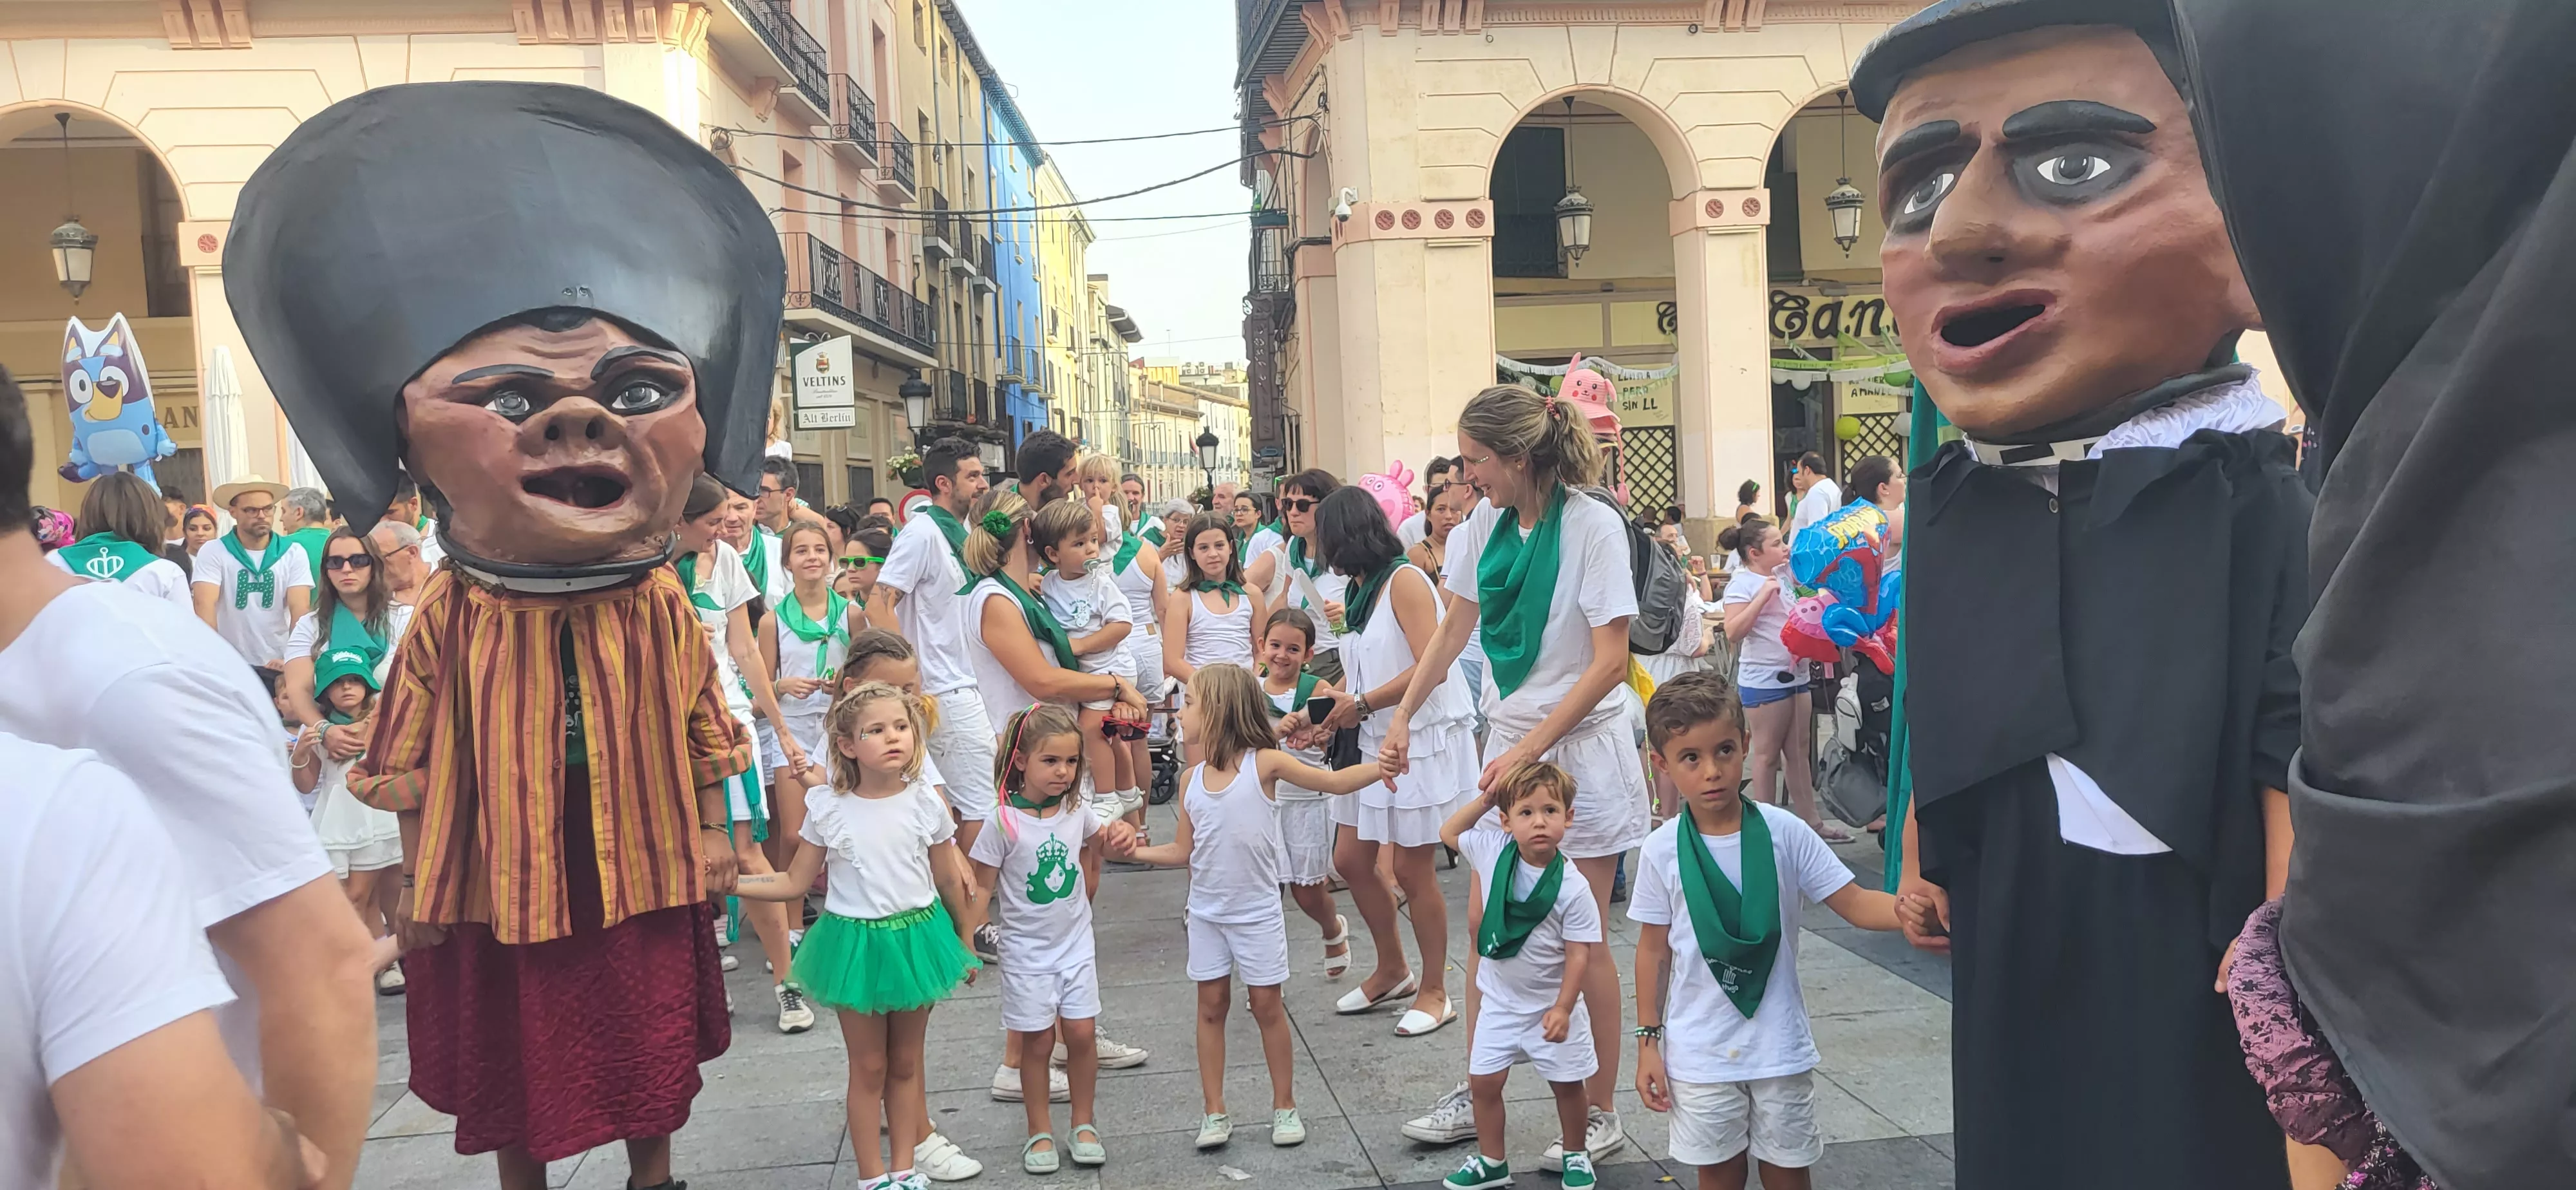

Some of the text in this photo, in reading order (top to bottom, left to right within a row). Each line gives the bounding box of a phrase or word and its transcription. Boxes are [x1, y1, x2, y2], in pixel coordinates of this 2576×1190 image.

[1769, 290, 1900, 339] Can
[802, 375, 846, 387] VELTINS
[1622, 397, 1658, 411] SIN LL
[802, 412, 851, 424] Alt Berlin
[235, 569, 274, 609] H
